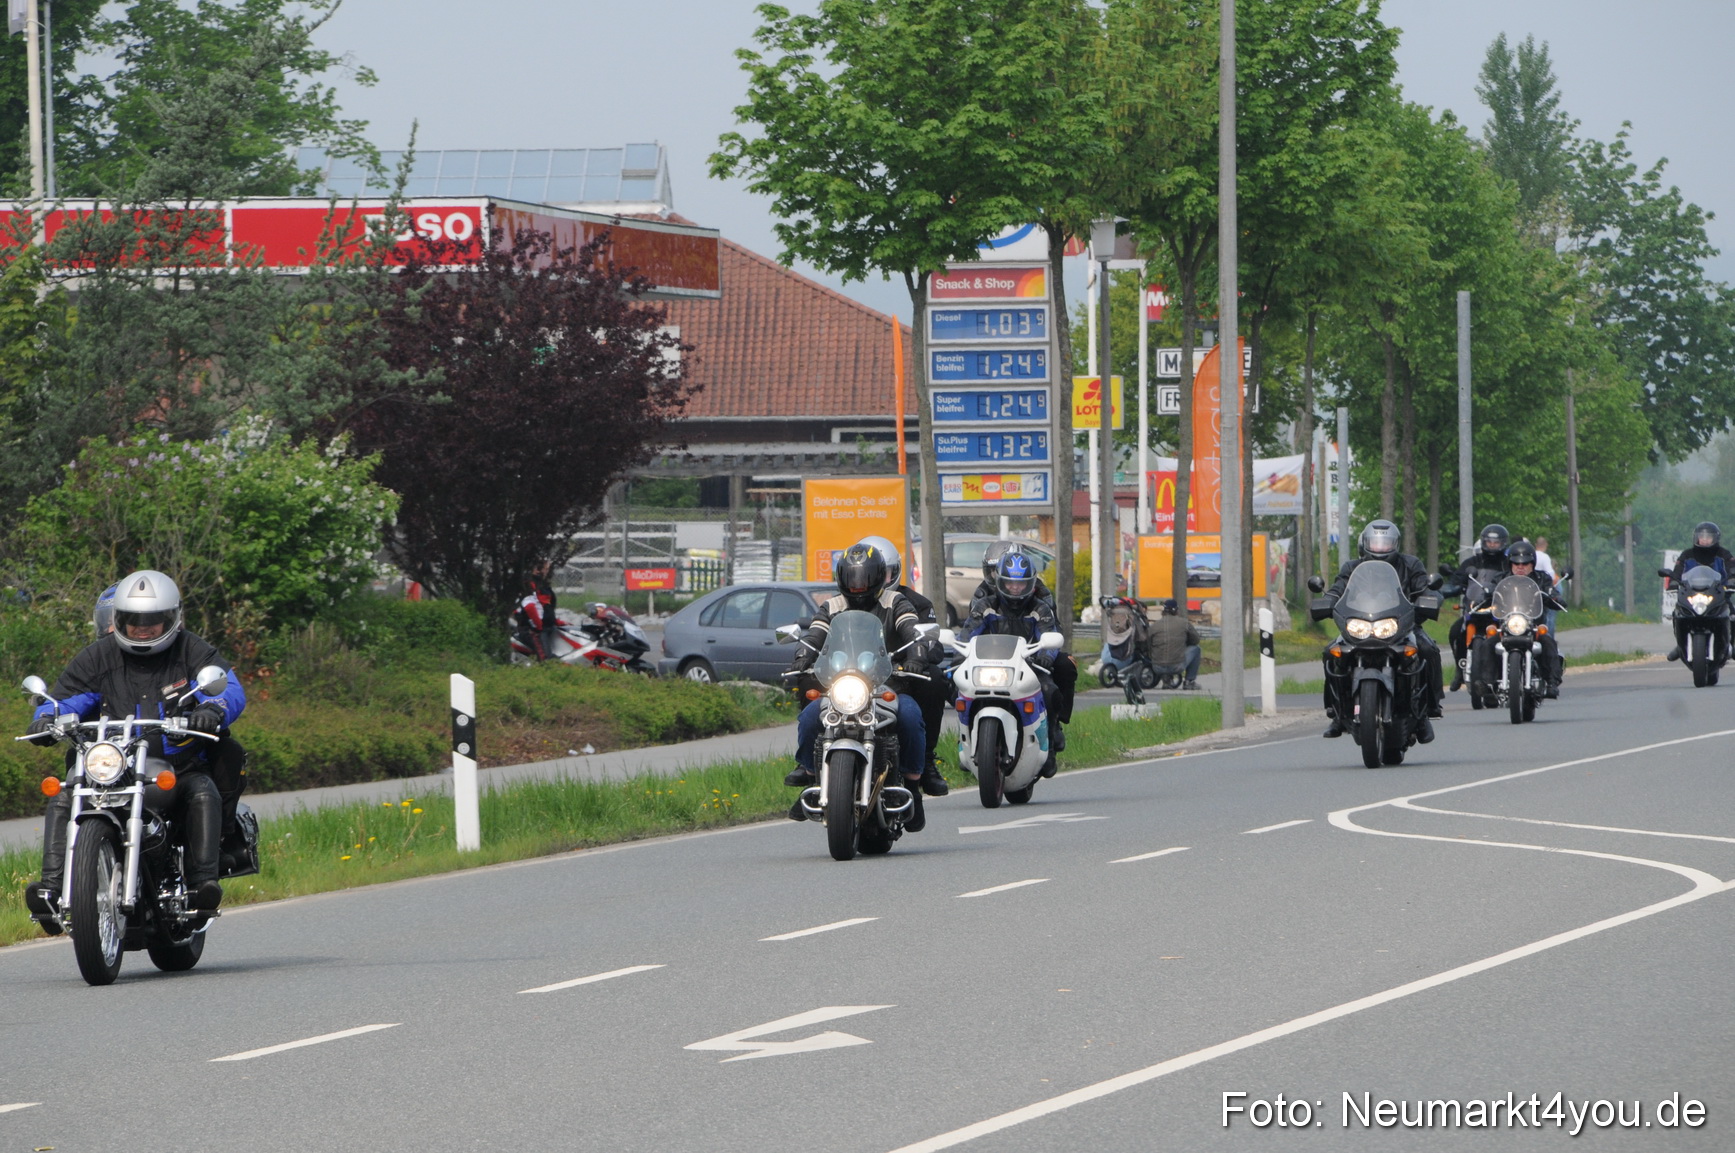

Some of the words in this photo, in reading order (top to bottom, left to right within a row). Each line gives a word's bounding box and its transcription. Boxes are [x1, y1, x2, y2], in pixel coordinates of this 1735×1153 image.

[935, 278, 971, 290] Snack
[973, 277, 983, 289] &
[985, 277, 1015, 290] Shop
[935, 313, 961, 322] Diesel
[936, 354, 965, 363] Benzin
[936, 363, 965, 372] bleifrei
[937, 395, 961, 405] Super
[936, 404, 965, 413] bleifrei
[938, 445, 967, 454] bleifrei
[813, 496, 858, 507] Belohnen
[860, 496, 876, 506] Sie
[878, 496, 897, 506] sich
[813, 509, 828, 519] mit
[831, 509, 855, 519] Esso
[857, 509, 888, 519] Extras
